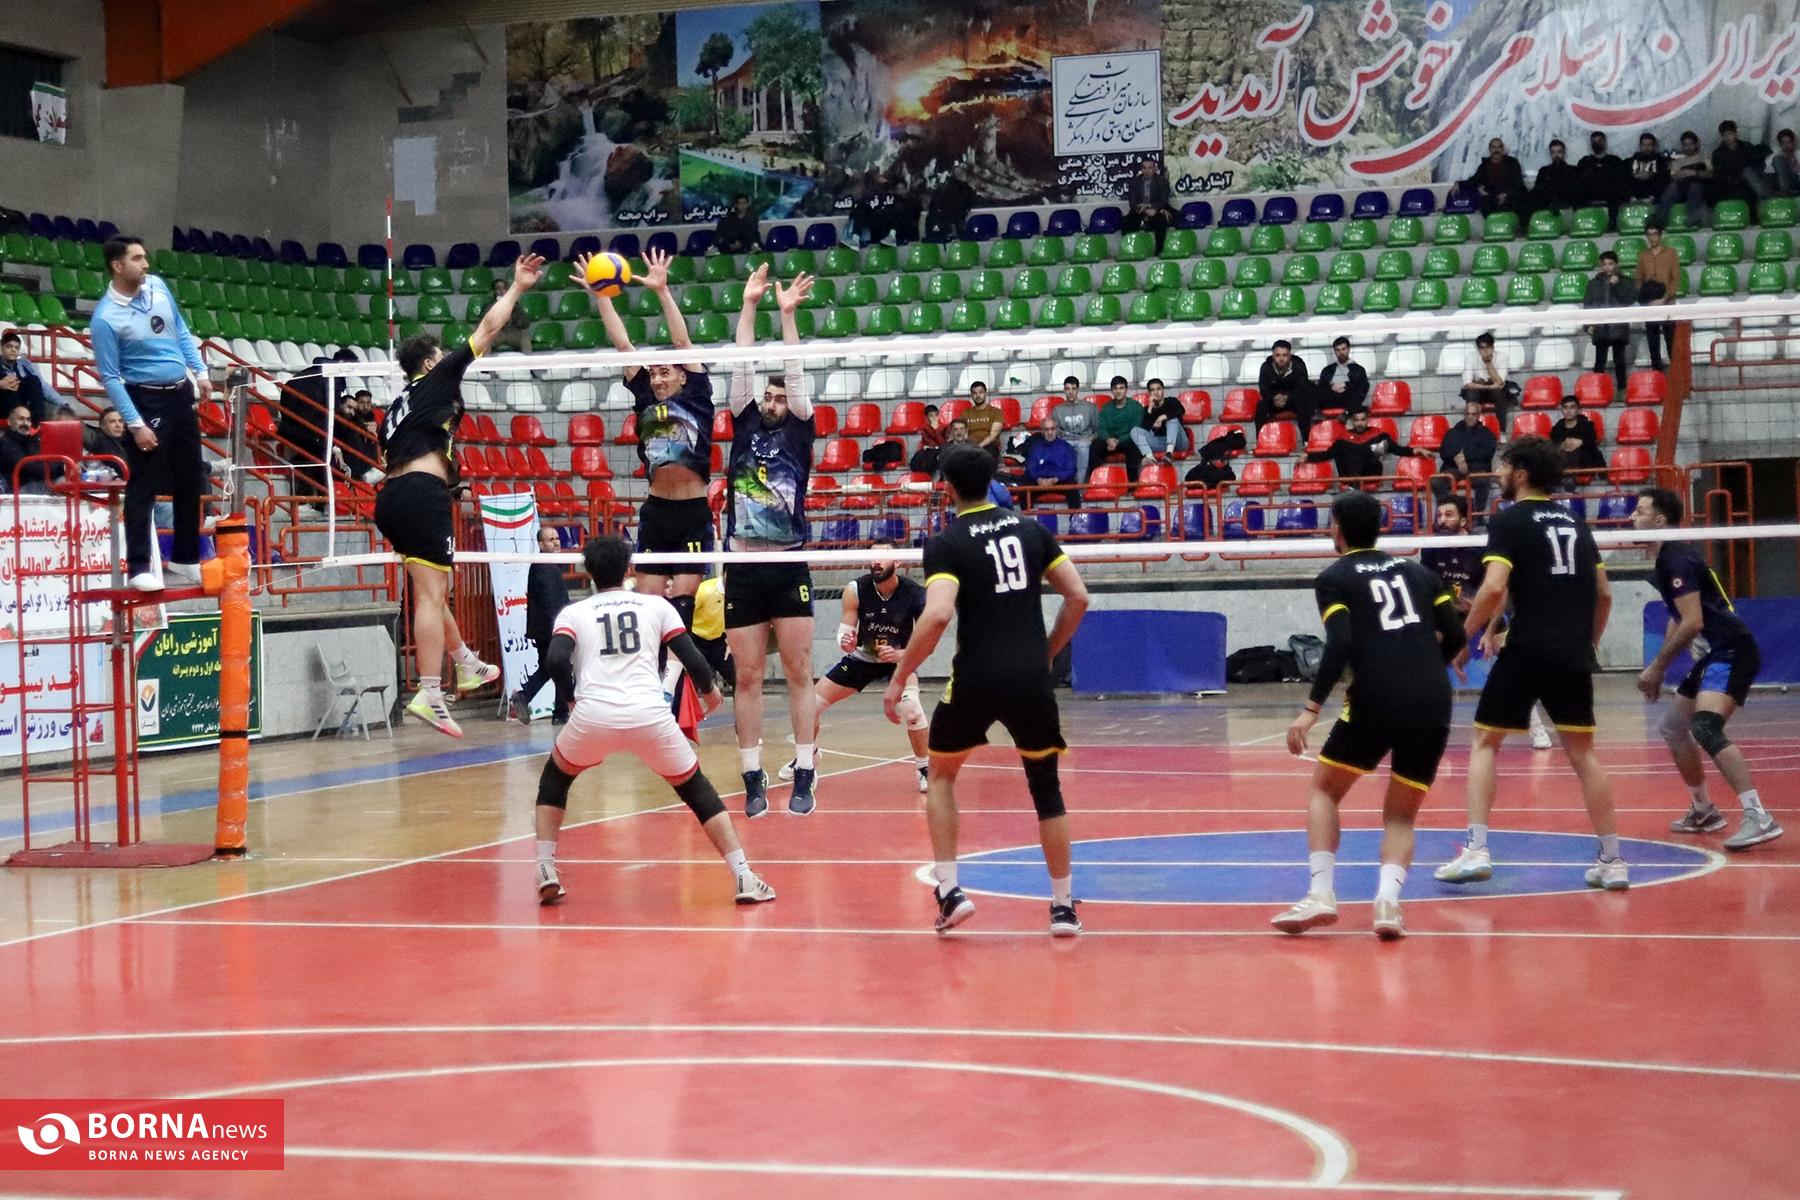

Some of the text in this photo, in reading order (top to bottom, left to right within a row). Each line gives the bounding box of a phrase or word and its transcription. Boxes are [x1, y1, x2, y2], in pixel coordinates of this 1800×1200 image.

[1301, 0, 1457, 143] خوش
[1170, 9, 1311, 159] آمدید
[1347, 27, 1625, 177] اسلامی
[1058, 156, 1092, 170] فرهنگی
[1121, 154, 1135, 167] کل
[1057, 170, 1099, 185] گردشگری
[1109, 169, 1134, 182] دستی
[1204, 171, 1233, 190] آبشار
[1076, 184, 1114, 197] کرمانشاه
[643, 208, 668, 222] سراب
[757, 467, 768, 483] 6
[1546, 526, 1578, 575] 17
[985, 535, 1027, 593] 19
[799, 585, 810, 603] 6
[1369, 574, 1421, 631] 21
[154, 627, 218, 657] آموزشی رایان
[596, 610, 642, 656] 18
